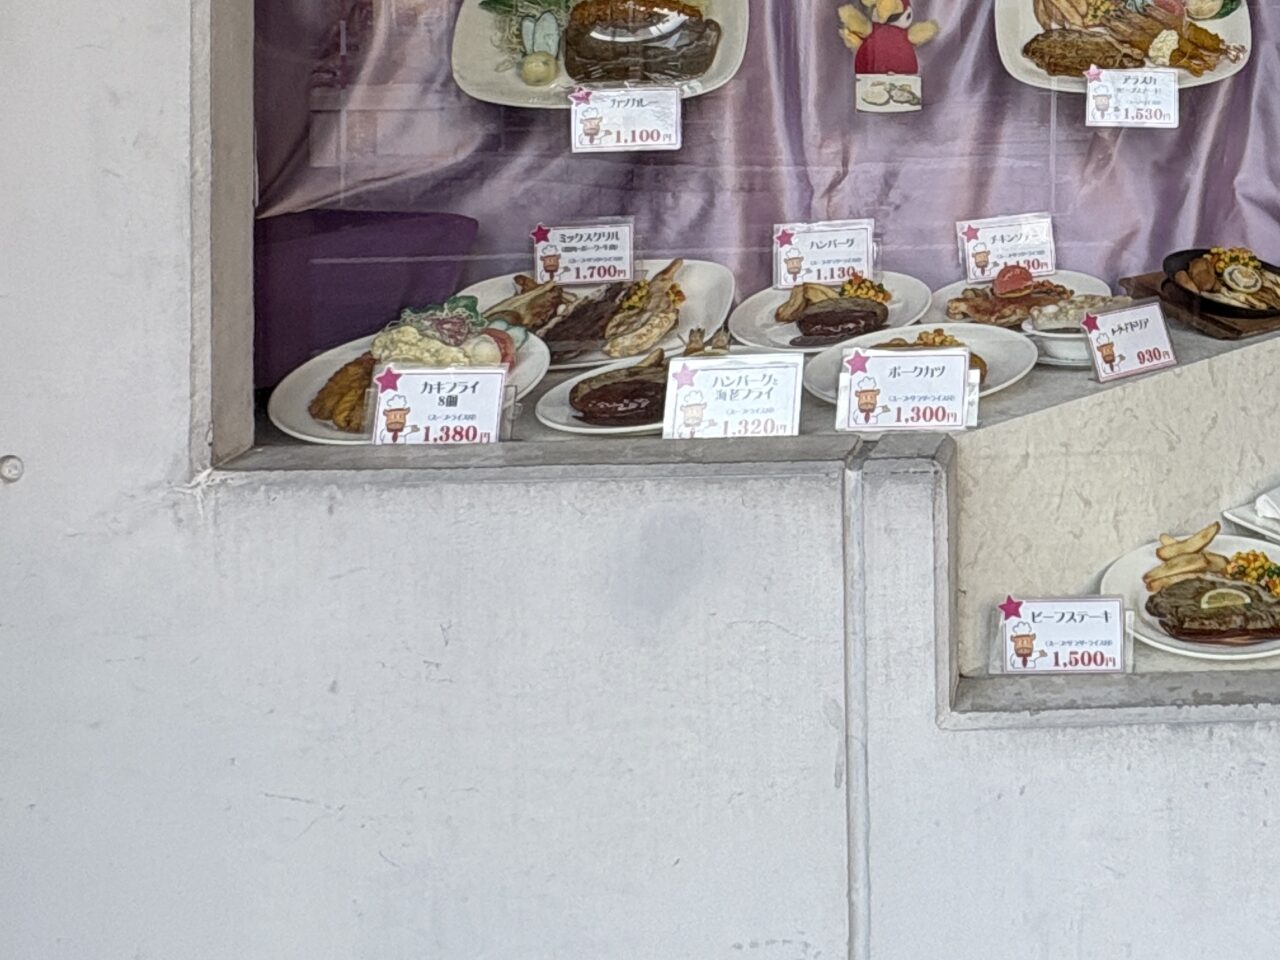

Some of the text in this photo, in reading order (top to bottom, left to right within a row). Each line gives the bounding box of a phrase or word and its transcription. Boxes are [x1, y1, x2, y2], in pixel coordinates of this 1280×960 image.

[615, 129, 672, 143] 1,100円
[559, 231, 620, 243] ミックスグリル
[810, 238, 855, 249] ハンバーグ
[575, 265, 627, 279] 1,700円
[1137, 347, 1170, 364] 930円
[888, 365, 946, 378] ポークカツ
[420, 381, 480, 394] カキフライ
[895, 406, 957, 423] 1,300円
[423, 425, 490, 443] 1,380円
[722, 418, 787, 436] 1,320円
[1031, 610, 1112, 623] ビーフステーキ
[1052, 650, 1116, 667] 1,500円
